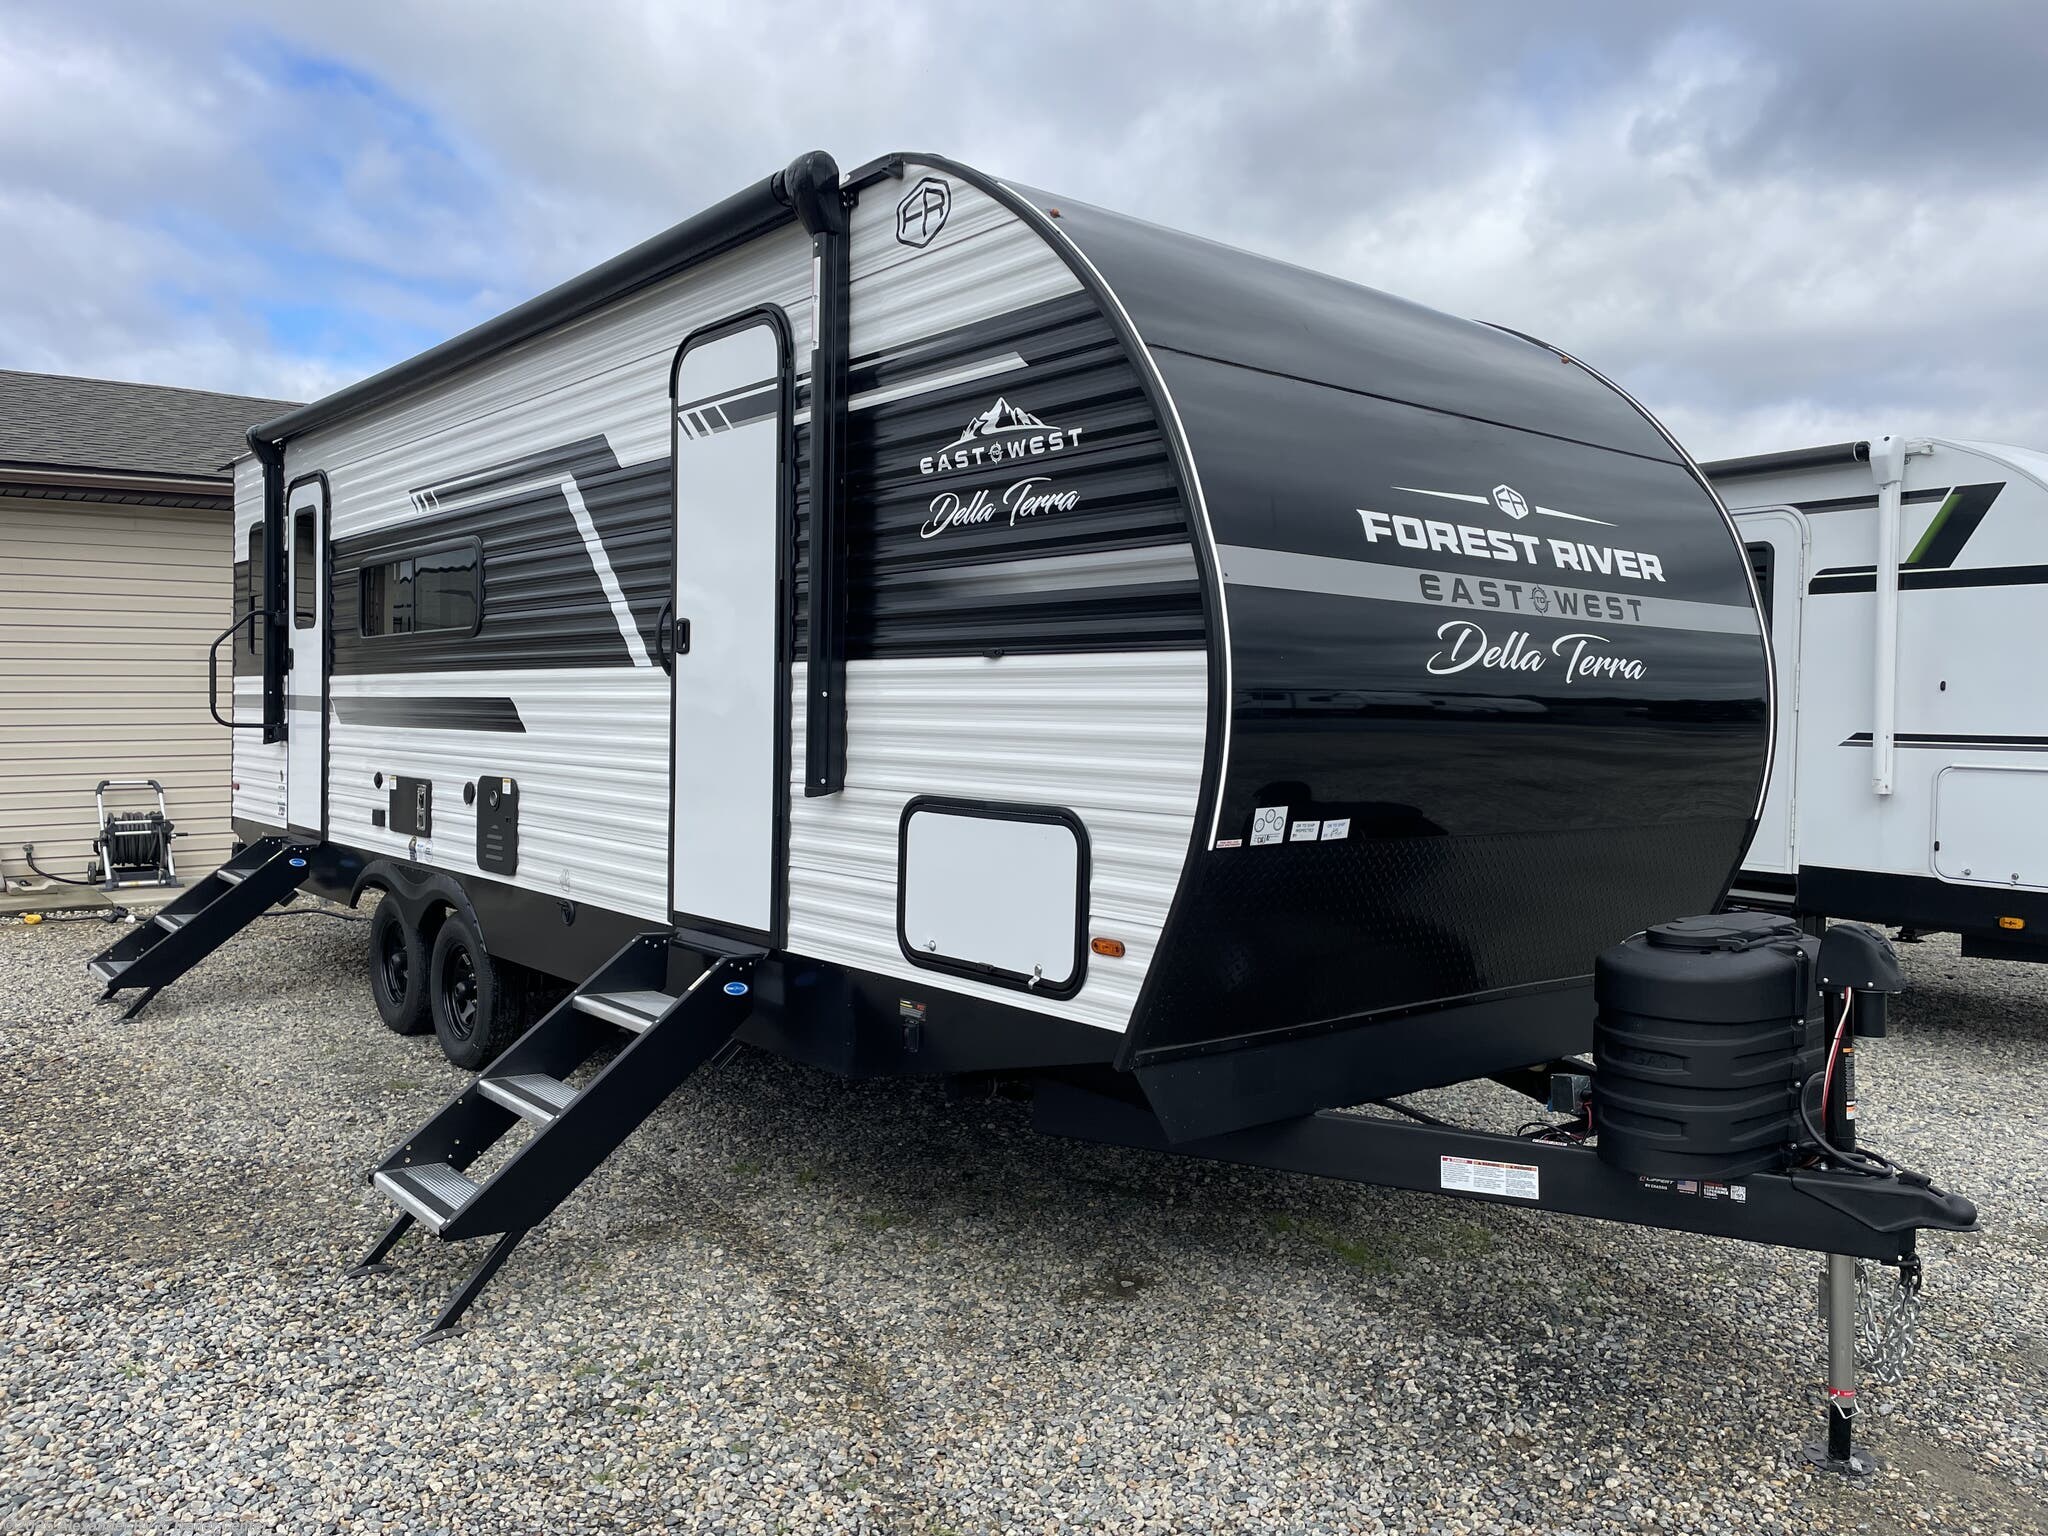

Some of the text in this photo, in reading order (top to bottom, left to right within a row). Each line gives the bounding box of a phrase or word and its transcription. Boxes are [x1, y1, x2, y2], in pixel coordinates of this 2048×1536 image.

[919, 446, 985, 475] EAST
[1006, 427, 1083, 459] WEST
[920, 476, 1081, 539] Della Terra
[1356, 508, 1666, 583] FOREST RIVER
[1419, 573, 1523, 610] EAST
[1553, 590, 1642, 622] WEST
[1426, 620, 1647, 685] Della Terra
